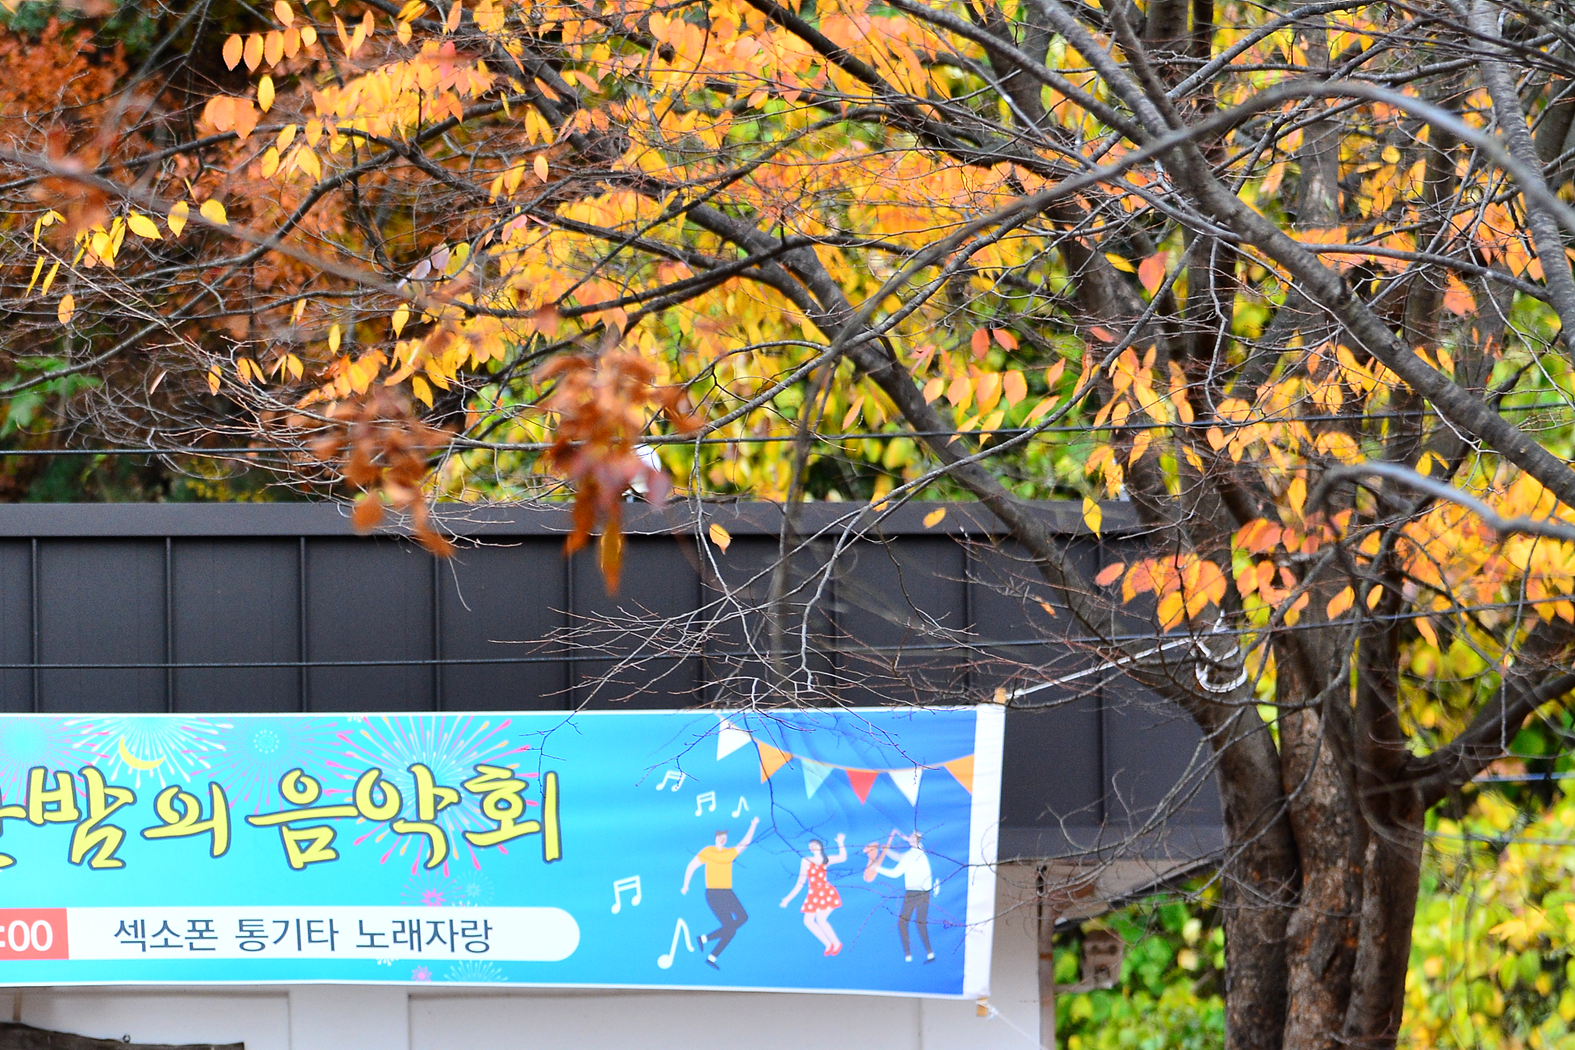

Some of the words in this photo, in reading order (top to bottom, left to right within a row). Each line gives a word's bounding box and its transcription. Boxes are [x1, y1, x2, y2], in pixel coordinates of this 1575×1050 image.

[246, 763, 562, 870] 음악회
[114, 918, 218, 953] 섹소폰
[235, 918, 339, 952] 통기타
[355, 918, 493, 954] 노래자랑
